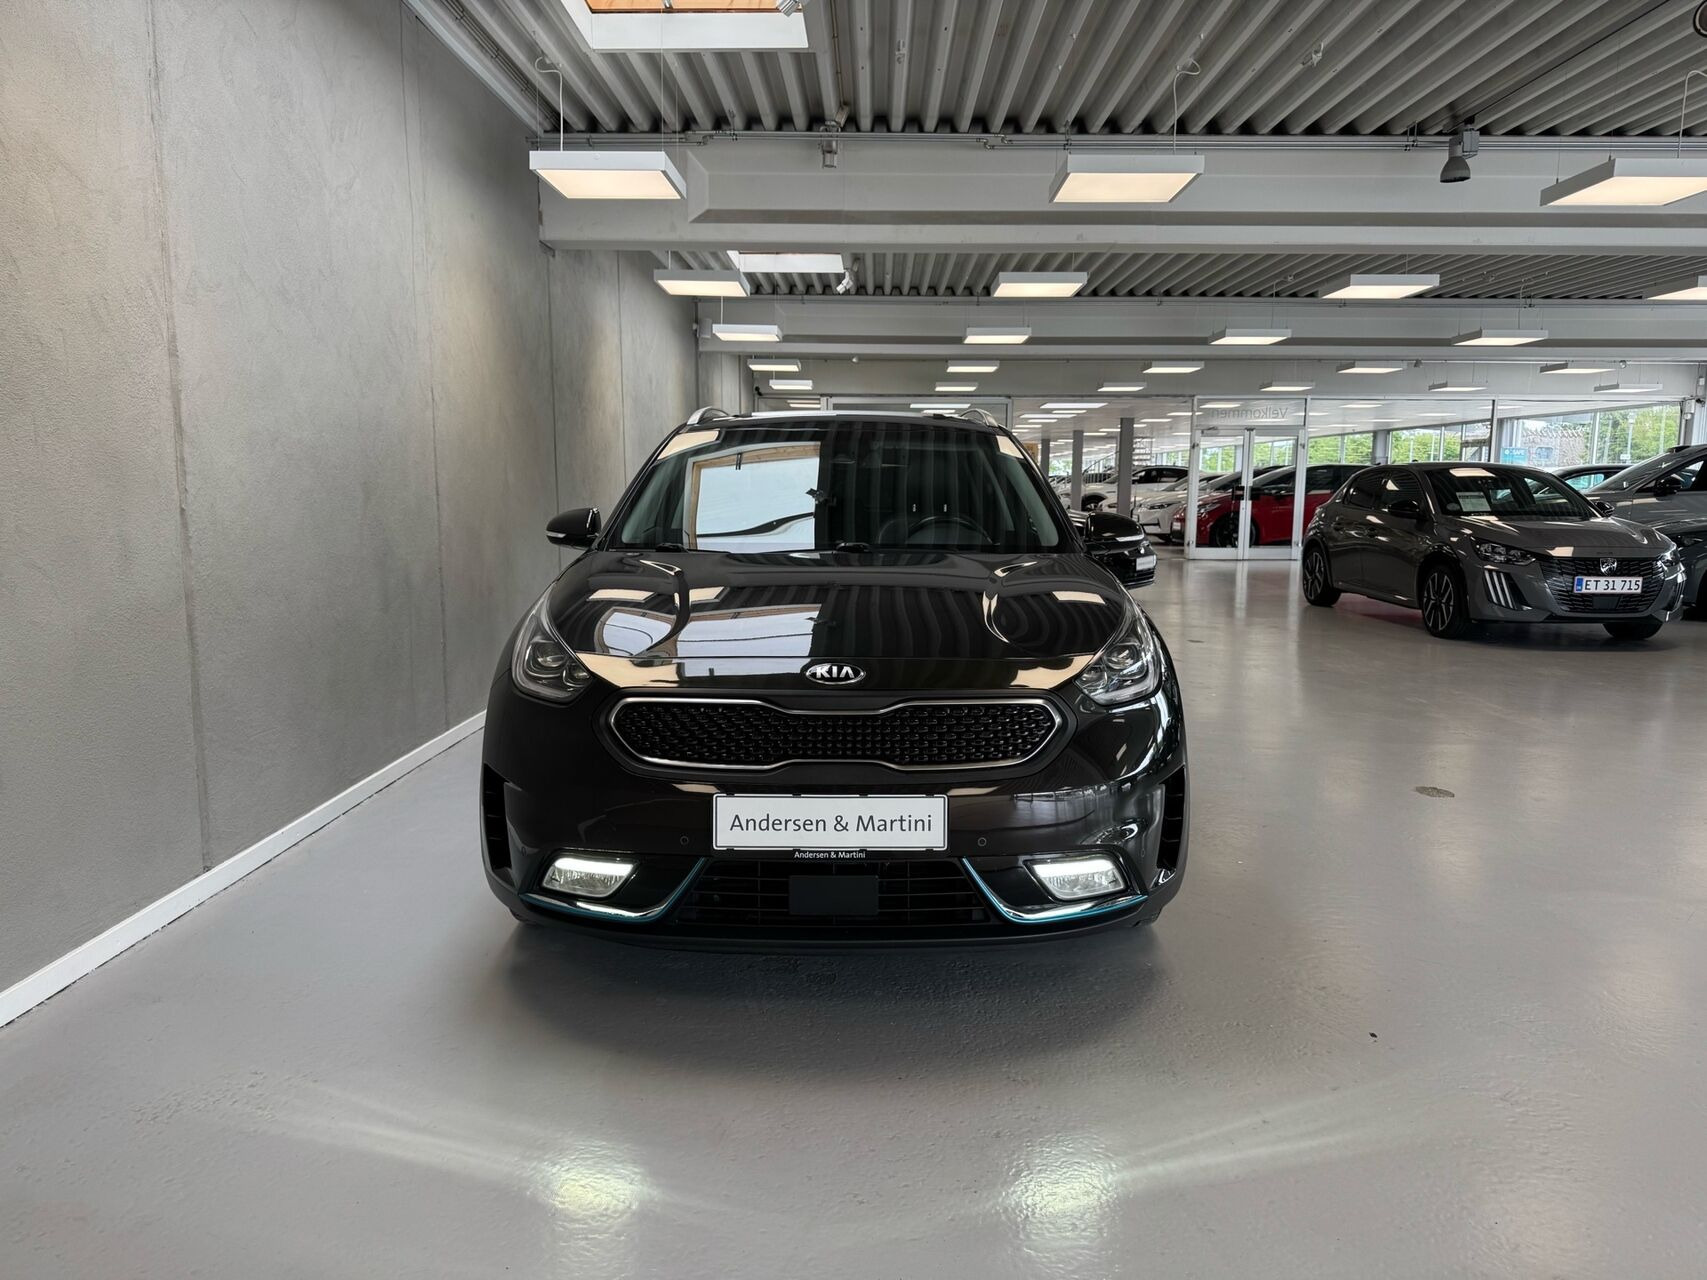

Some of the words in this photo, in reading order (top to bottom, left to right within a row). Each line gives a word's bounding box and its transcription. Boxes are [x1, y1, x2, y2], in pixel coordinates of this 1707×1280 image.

[1584, 579, 1601, 591] ET
[1603, 579, 1617, 591] 31
[1620, 579, 1641, 591] 715
[815, 664, 855, 679] KIA
[729, 813, 827, 832] Andersen
[833, 815, 849, 832] &
[855, 814, 933, 832] Martini
[793, 850, 829, 859] Andersen
[830, 851, 837, 859] &
[838, 850, 866, 859] Martini
